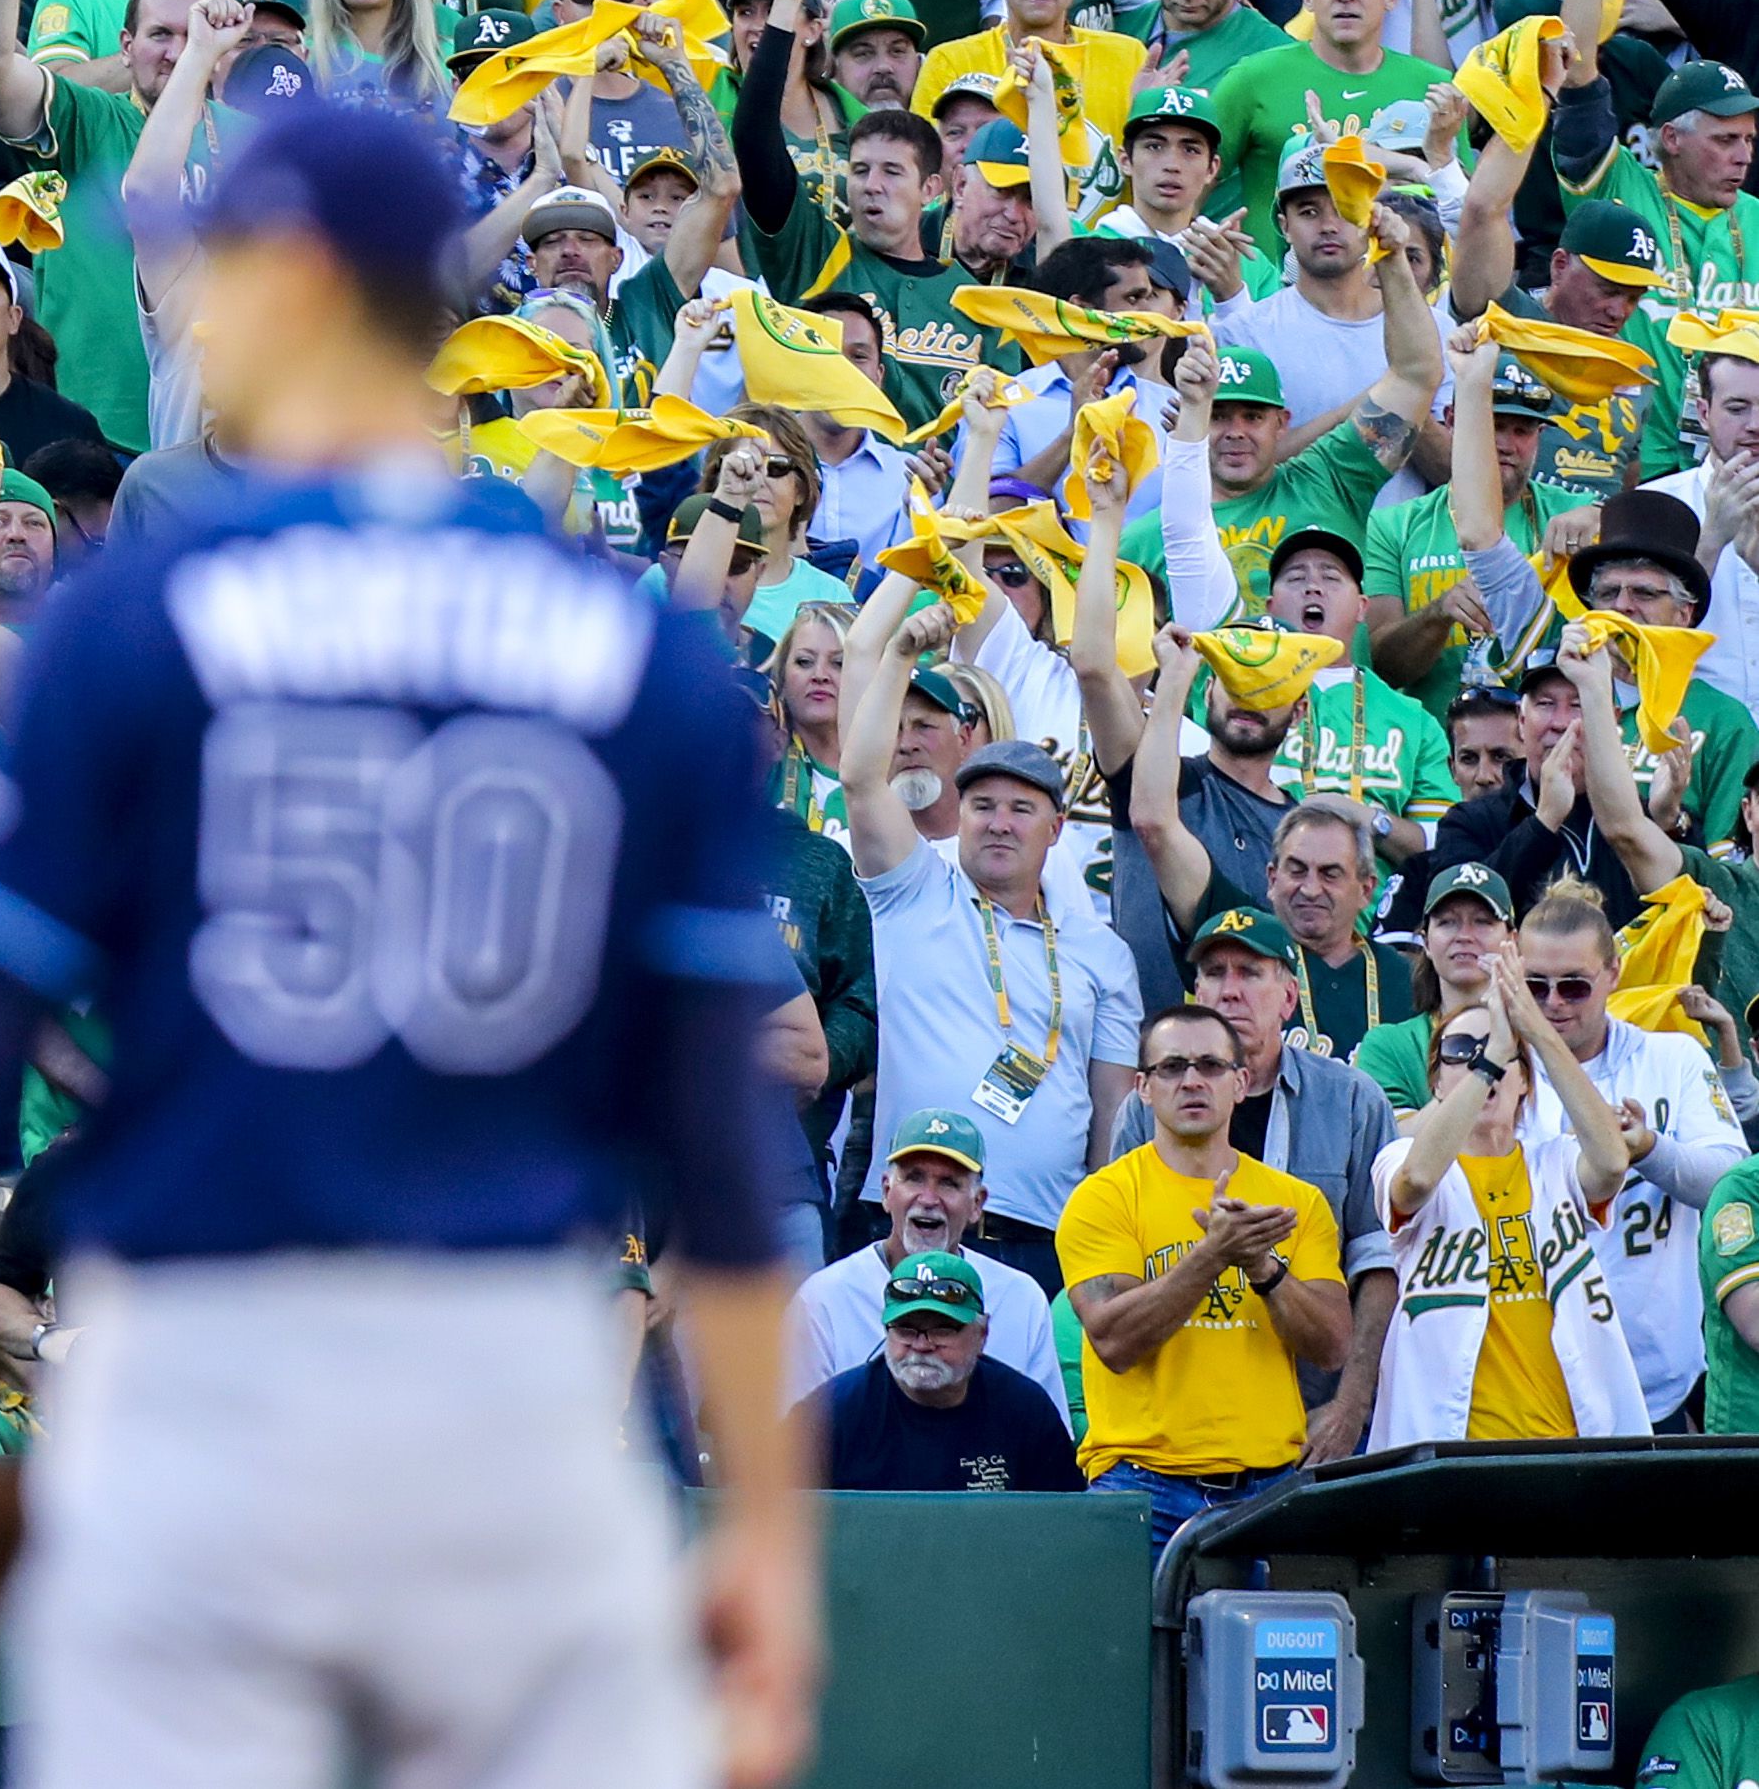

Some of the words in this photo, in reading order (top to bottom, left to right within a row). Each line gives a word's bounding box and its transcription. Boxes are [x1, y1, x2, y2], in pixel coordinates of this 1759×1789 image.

[187, 701, 621, 1077] 50
[1587, 1282, 1615, 1324] 5
[1267, 1630, 1327, 1651] DUGOUT
[1282, 1668, 1334, 1693] Mitel
